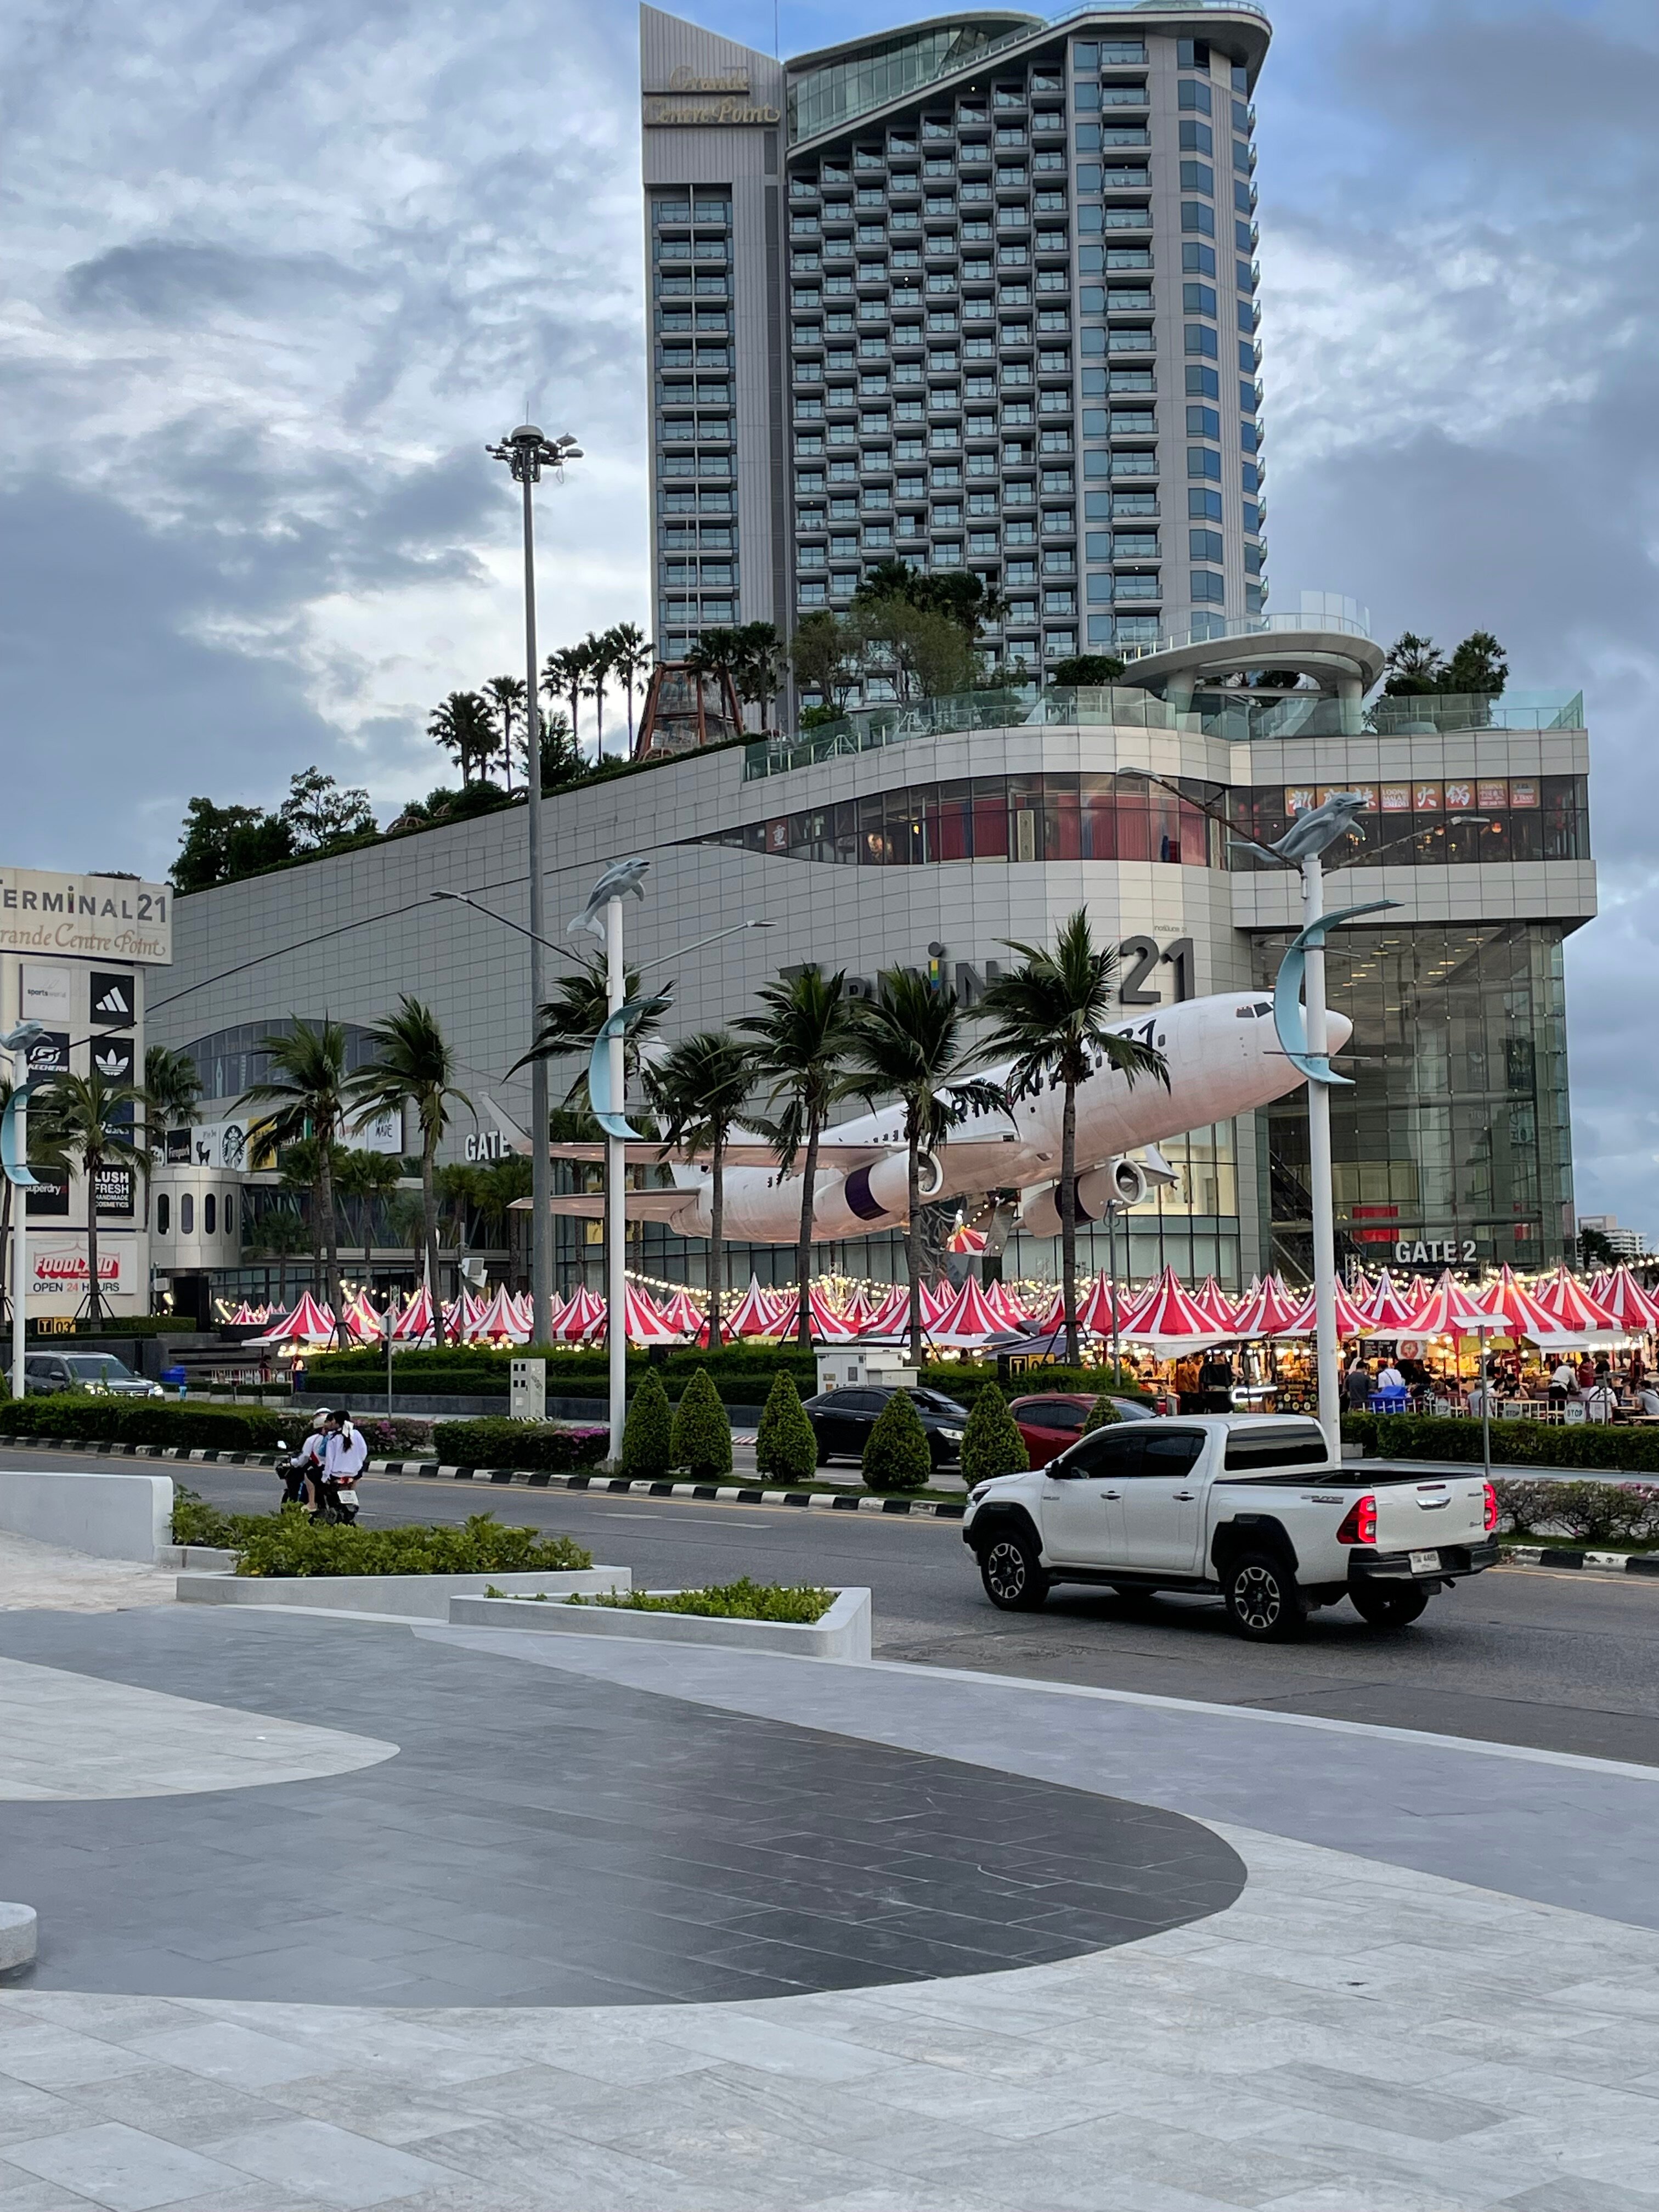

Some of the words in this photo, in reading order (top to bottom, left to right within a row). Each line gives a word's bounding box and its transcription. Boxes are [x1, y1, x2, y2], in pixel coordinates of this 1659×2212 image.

[0, 925, 52, 945] rande
[55, 923, 111, 950] Centre
[114, 930, 166, 956] Point
[27, 1064, 68, 1072] KECHERS
[94, 1171, 129, 1183] LUSH
[95, 1183, 129, 1194] FRESH
[1395, 1240, 1458, 1263] GATE
[1463, 1240, 1477, 1262] 2
[33, 1282, 63, 1292] OPEN
[66, 1283, 78, 1292] 24
[82, 1282, 120, 1292] HURS
